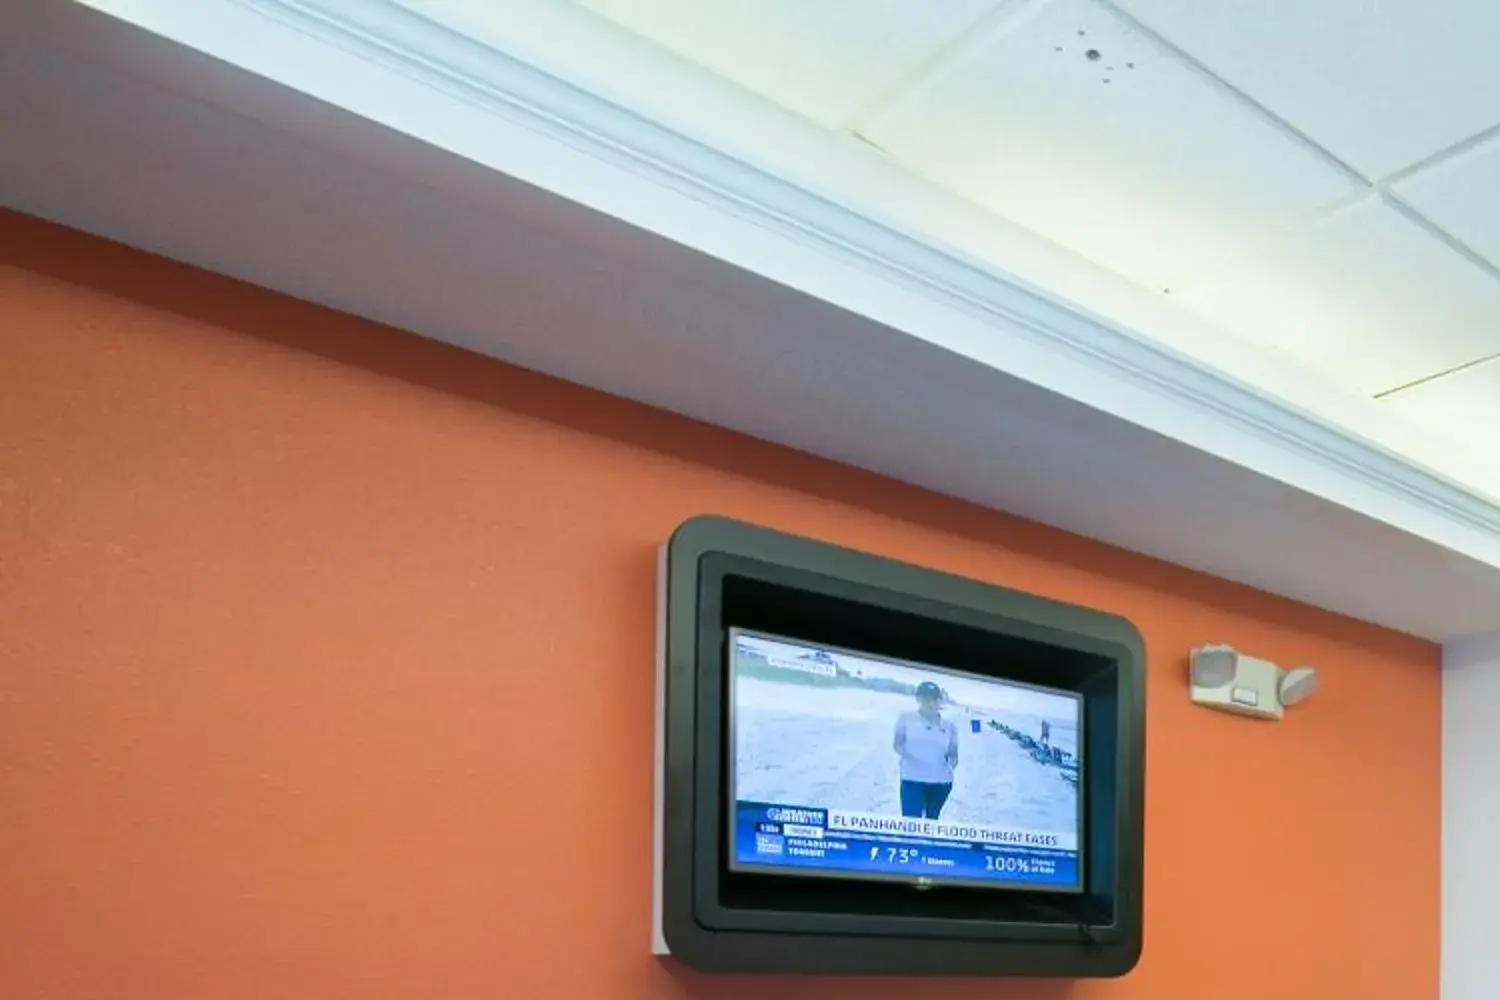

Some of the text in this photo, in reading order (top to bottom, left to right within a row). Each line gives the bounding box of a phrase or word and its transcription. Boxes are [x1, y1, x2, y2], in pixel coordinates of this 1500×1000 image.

[833, 815, 847, 827] FL
[937, 825, 978, 840] FLOOD
[980, 829, 1023, 844] THREAT
[1025, 834, 1058, 847] EASES
[985, 855, 1029, 874] 100%
